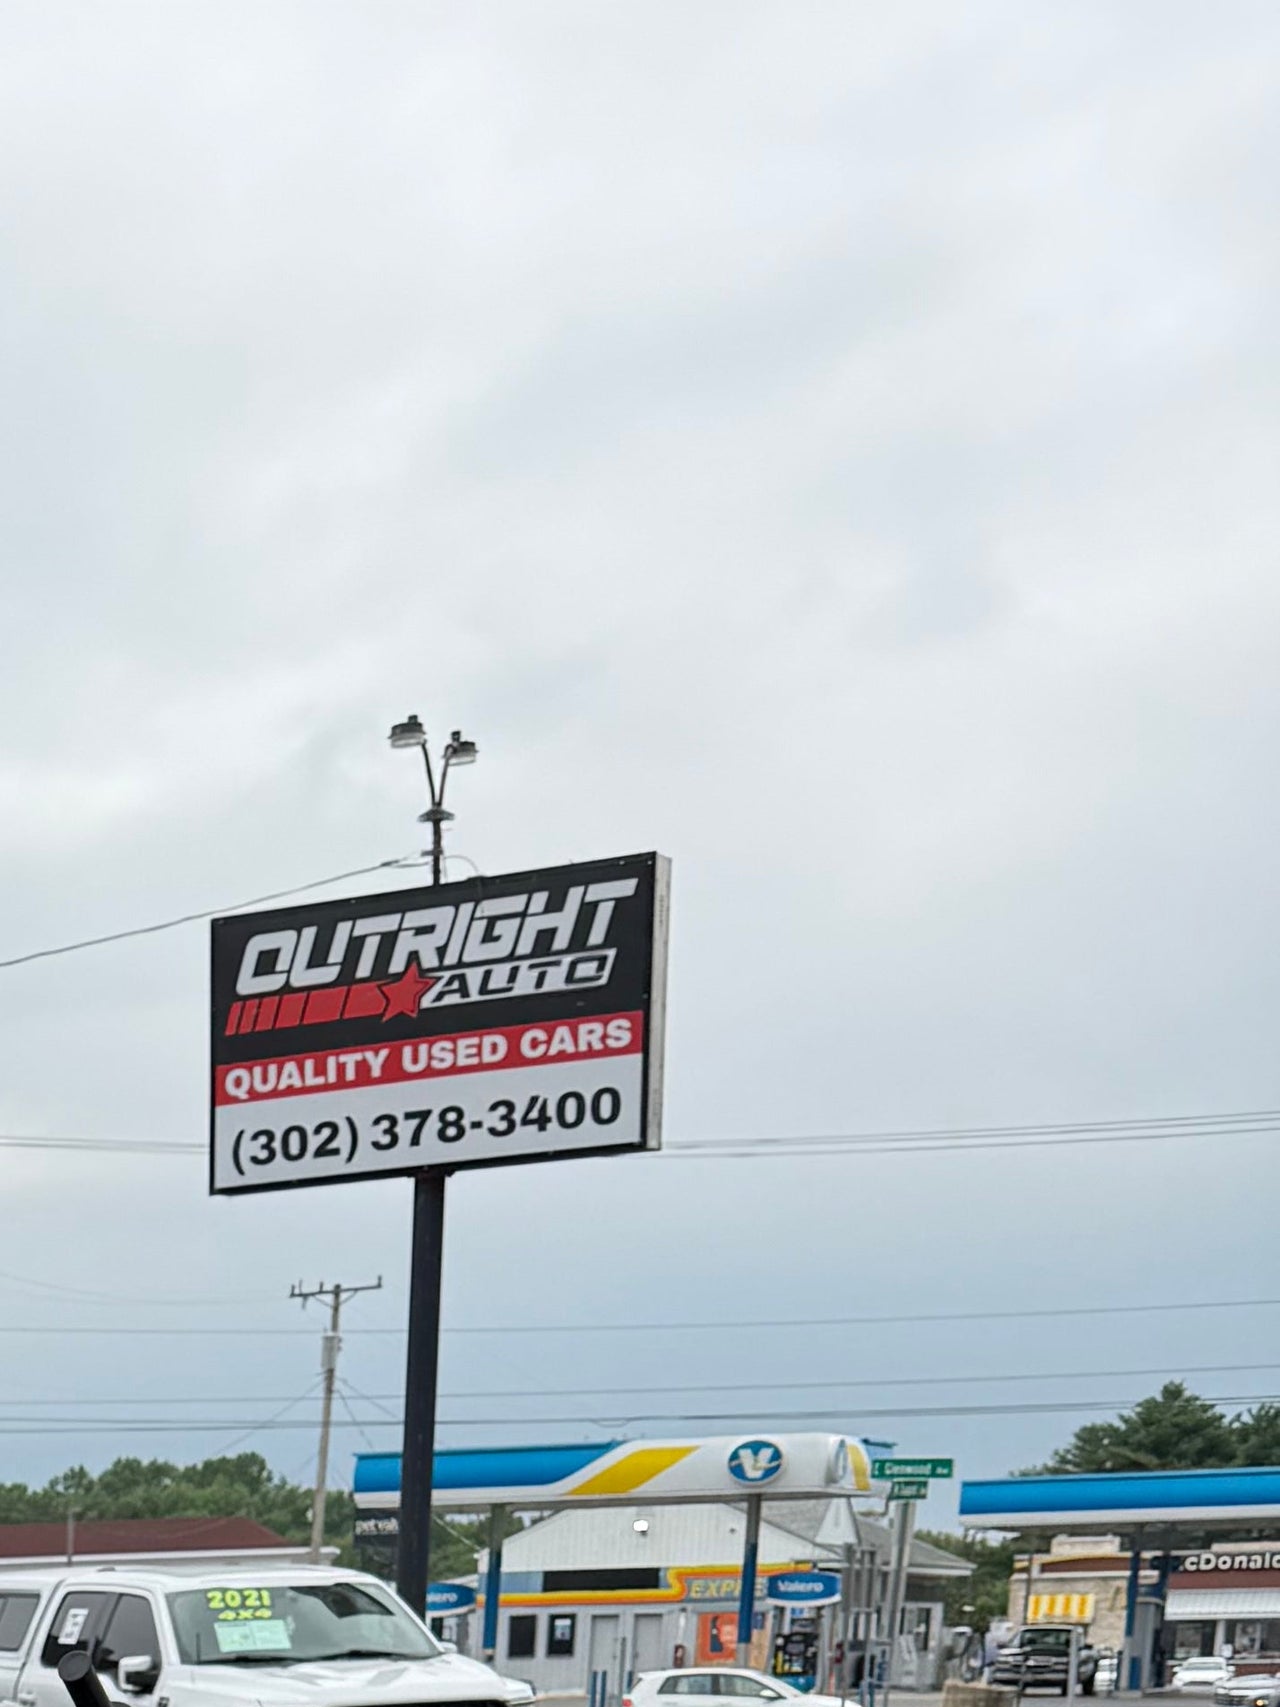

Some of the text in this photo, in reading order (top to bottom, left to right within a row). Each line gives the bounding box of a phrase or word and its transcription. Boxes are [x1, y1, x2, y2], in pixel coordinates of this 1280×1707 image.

[236, 878, 638, 996] OUTRIGHT
[433, 953, 614, 1003] AUTO
[224, 1018, 632, 1100] QUALITY USED CARS
[232, 1086, 621, 1176] (302) 378-3400
[778, 1579, 825, 1593] Valero
[1179, 1552, 1280, 1572] cDonal
[206, 1589, 271, 1609] 2021
